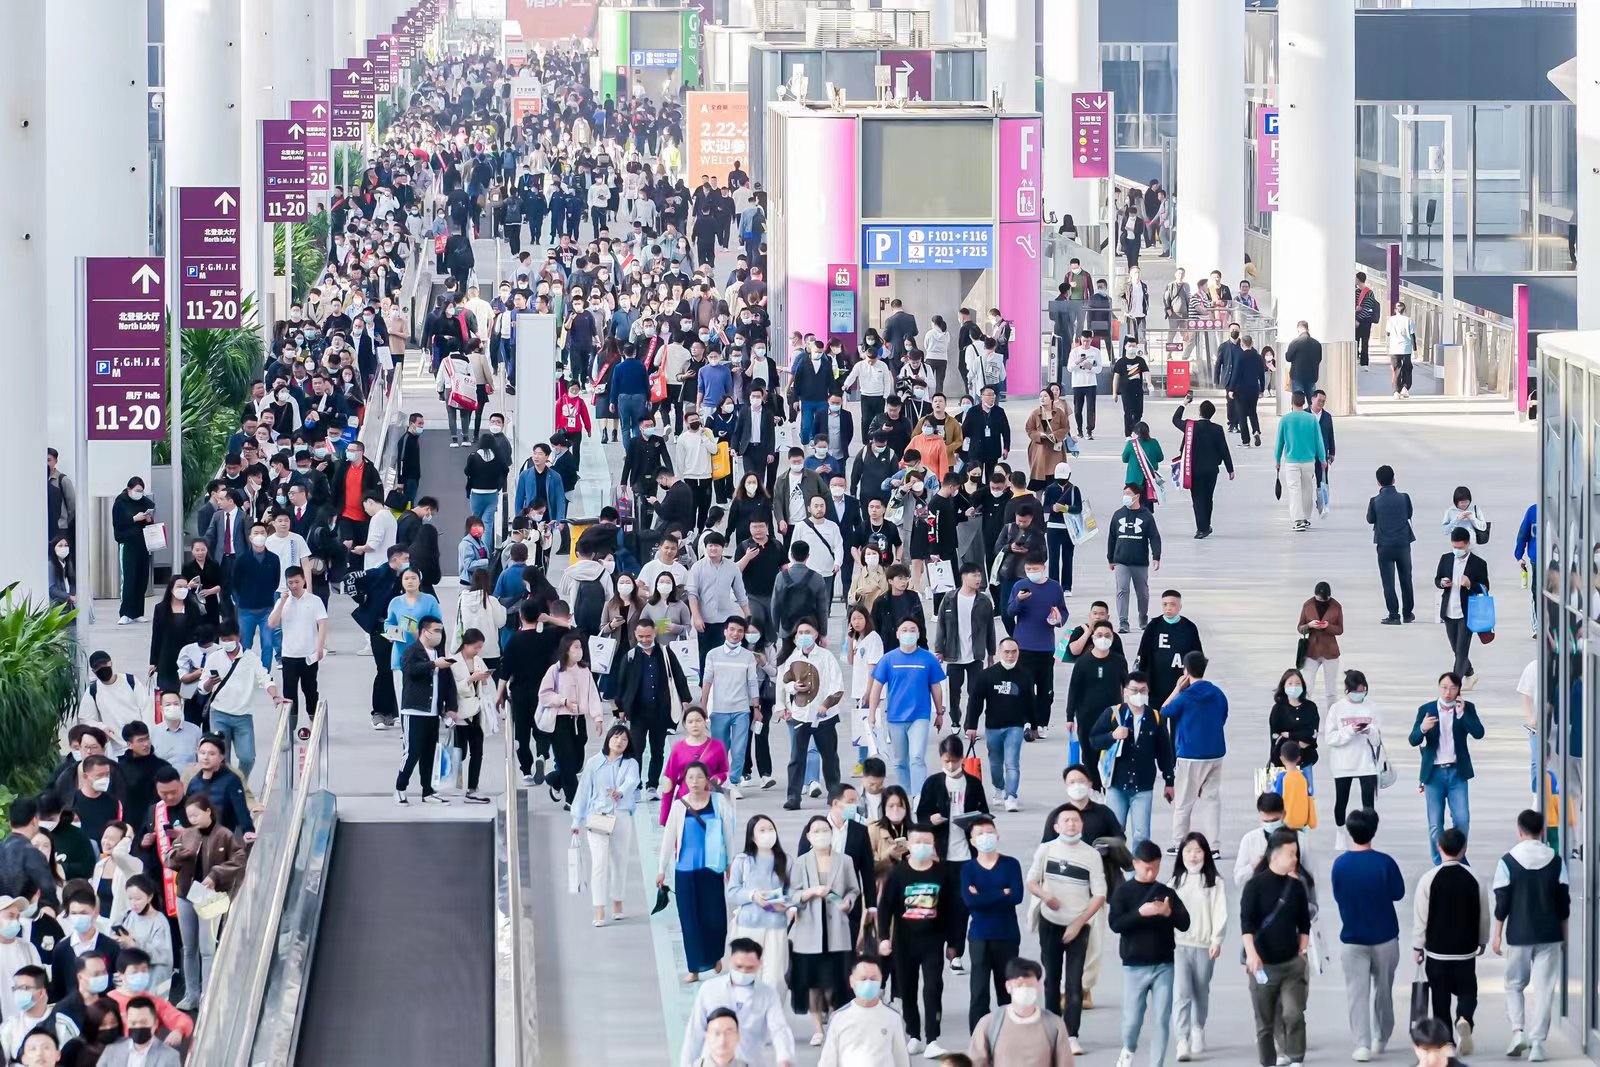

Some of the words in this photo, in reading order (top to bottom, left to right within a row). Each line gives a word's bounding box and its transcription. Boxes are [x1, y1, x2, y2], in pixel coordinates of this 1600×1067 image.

[688, 13, 697, 32] G
[634, 53, 641, 65] P
[332, 126, 360, 137] 13-20
[701, 138, 749, 155] 欢迎参
[1020, 126, 1034, 170] F
[306, 172, 327, 186] -20
[268, 201, 305, 217] 11-20
[220, 236, 236, 244] Lobby
[928, 230, 954, 242] F101
[962, 230, 988, 242] F116
[875, 233, 892, 261] P
[928, 246, 954, 257] F201
[962, 246, 988, 257] F215
[186, 300, 237, 320] 11-20
[118, 322, 139, 331] North
[139, 322, 160, 332] Lobby
[112, 368, 121, 378] M
[144, 392, 161, 400] Halls
[95, 405, 161, 430] 11-20
[1158, 633, 1171, 648] E
